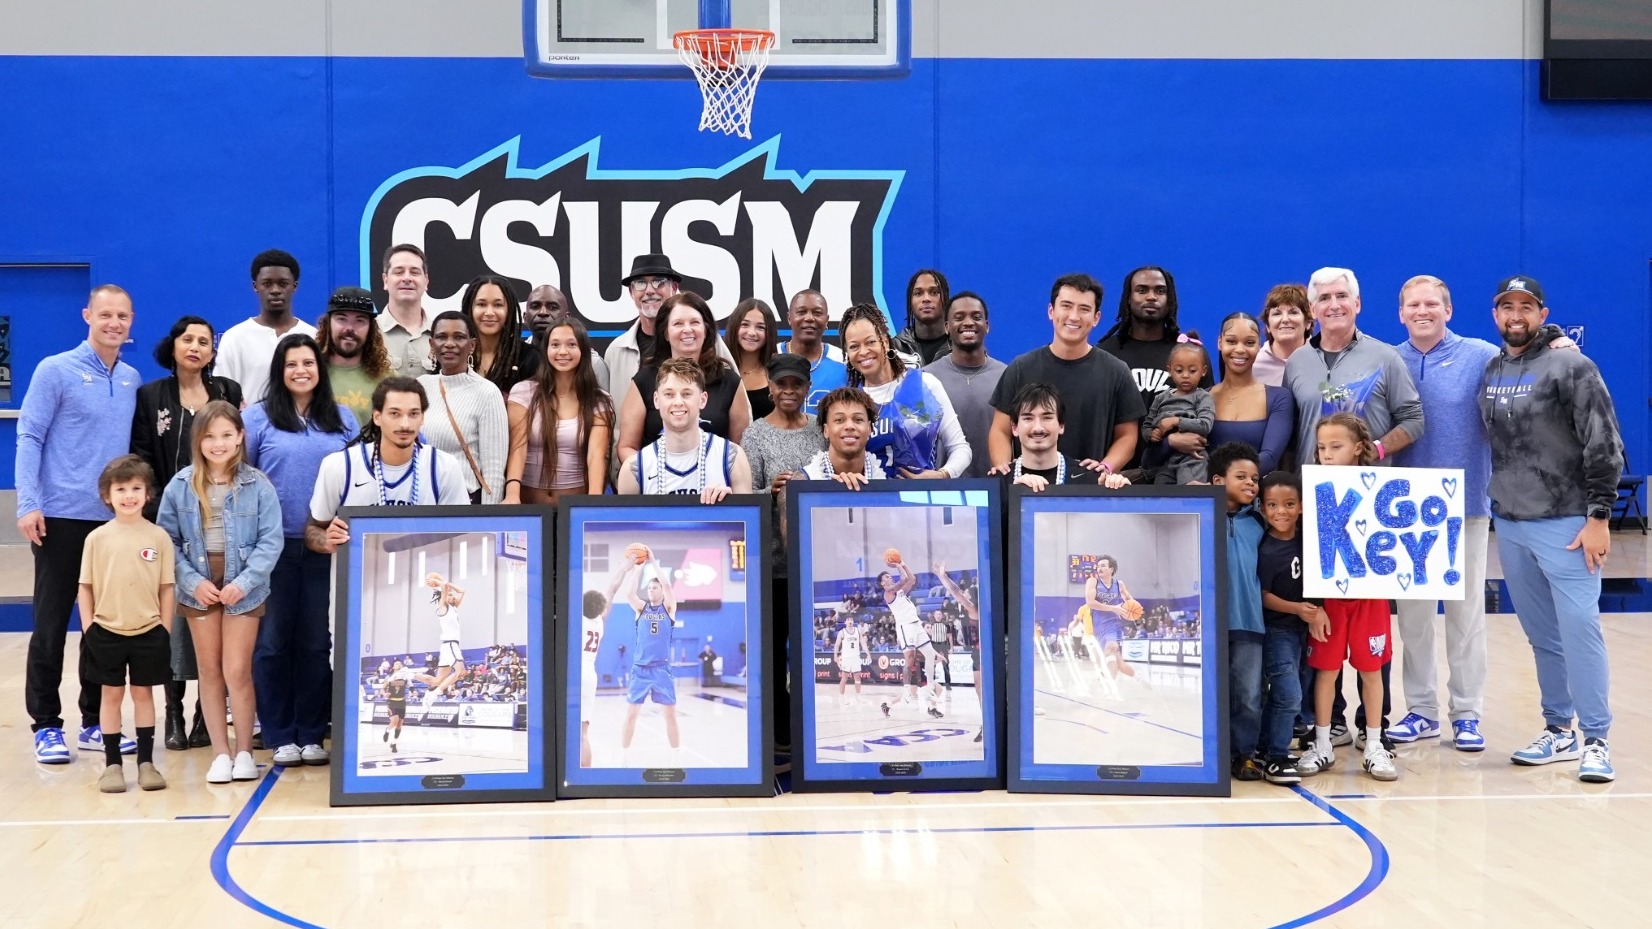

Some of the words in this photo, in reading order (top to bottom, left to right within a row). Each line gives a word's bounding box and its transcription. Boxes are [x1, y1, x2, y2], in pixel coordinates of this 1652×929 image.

[391, 189, 860, 323] CSUSM
[1374, 478, 1448, 528] Go
[584, 631, 600, 653] 23
[651, 622, 659, 634] 5
